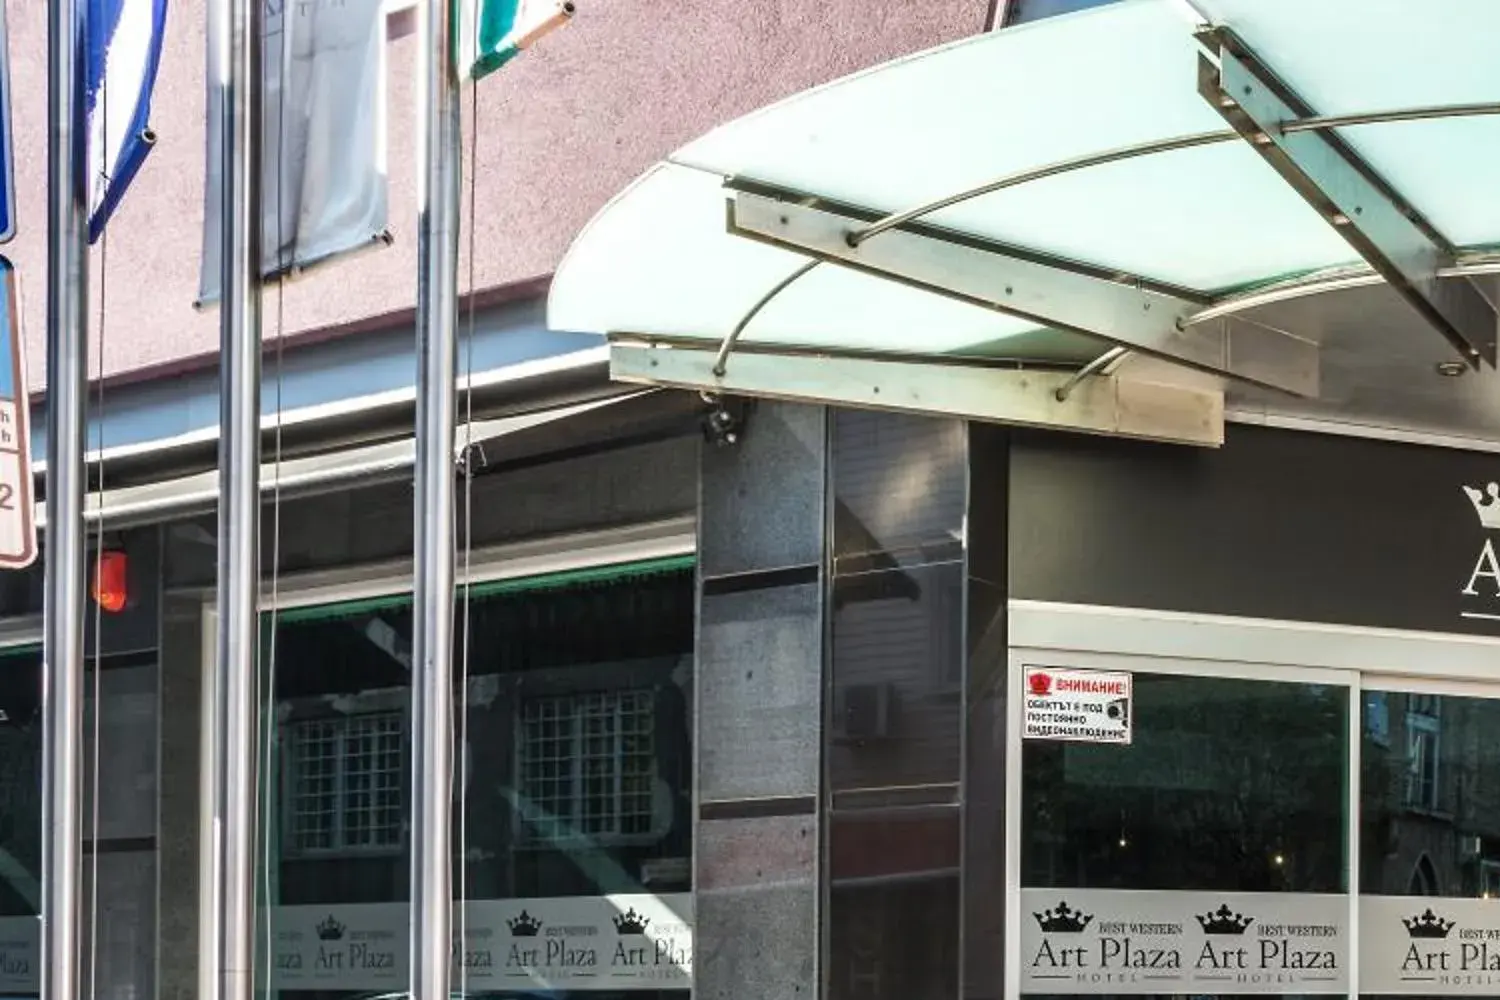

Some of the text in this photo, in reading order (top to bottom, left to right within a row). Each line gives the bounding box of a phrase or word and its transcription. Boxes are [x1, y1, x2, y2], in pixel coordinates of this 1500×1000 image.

[1256, 924, 1338, 937] BEST WESTERN
[313, 942, 395, 970] Art Plaza
[505, 939, 598, 968] Art Plaza
[611, 940, 647, 966] Art
[1031, 937, 1182, 969] Art Plaza
[1195, 939, 1338, 970] Art Plaza
[1401, 941, 1452, 972] Art
[1236, 973, 1295, 985] HOTEL
